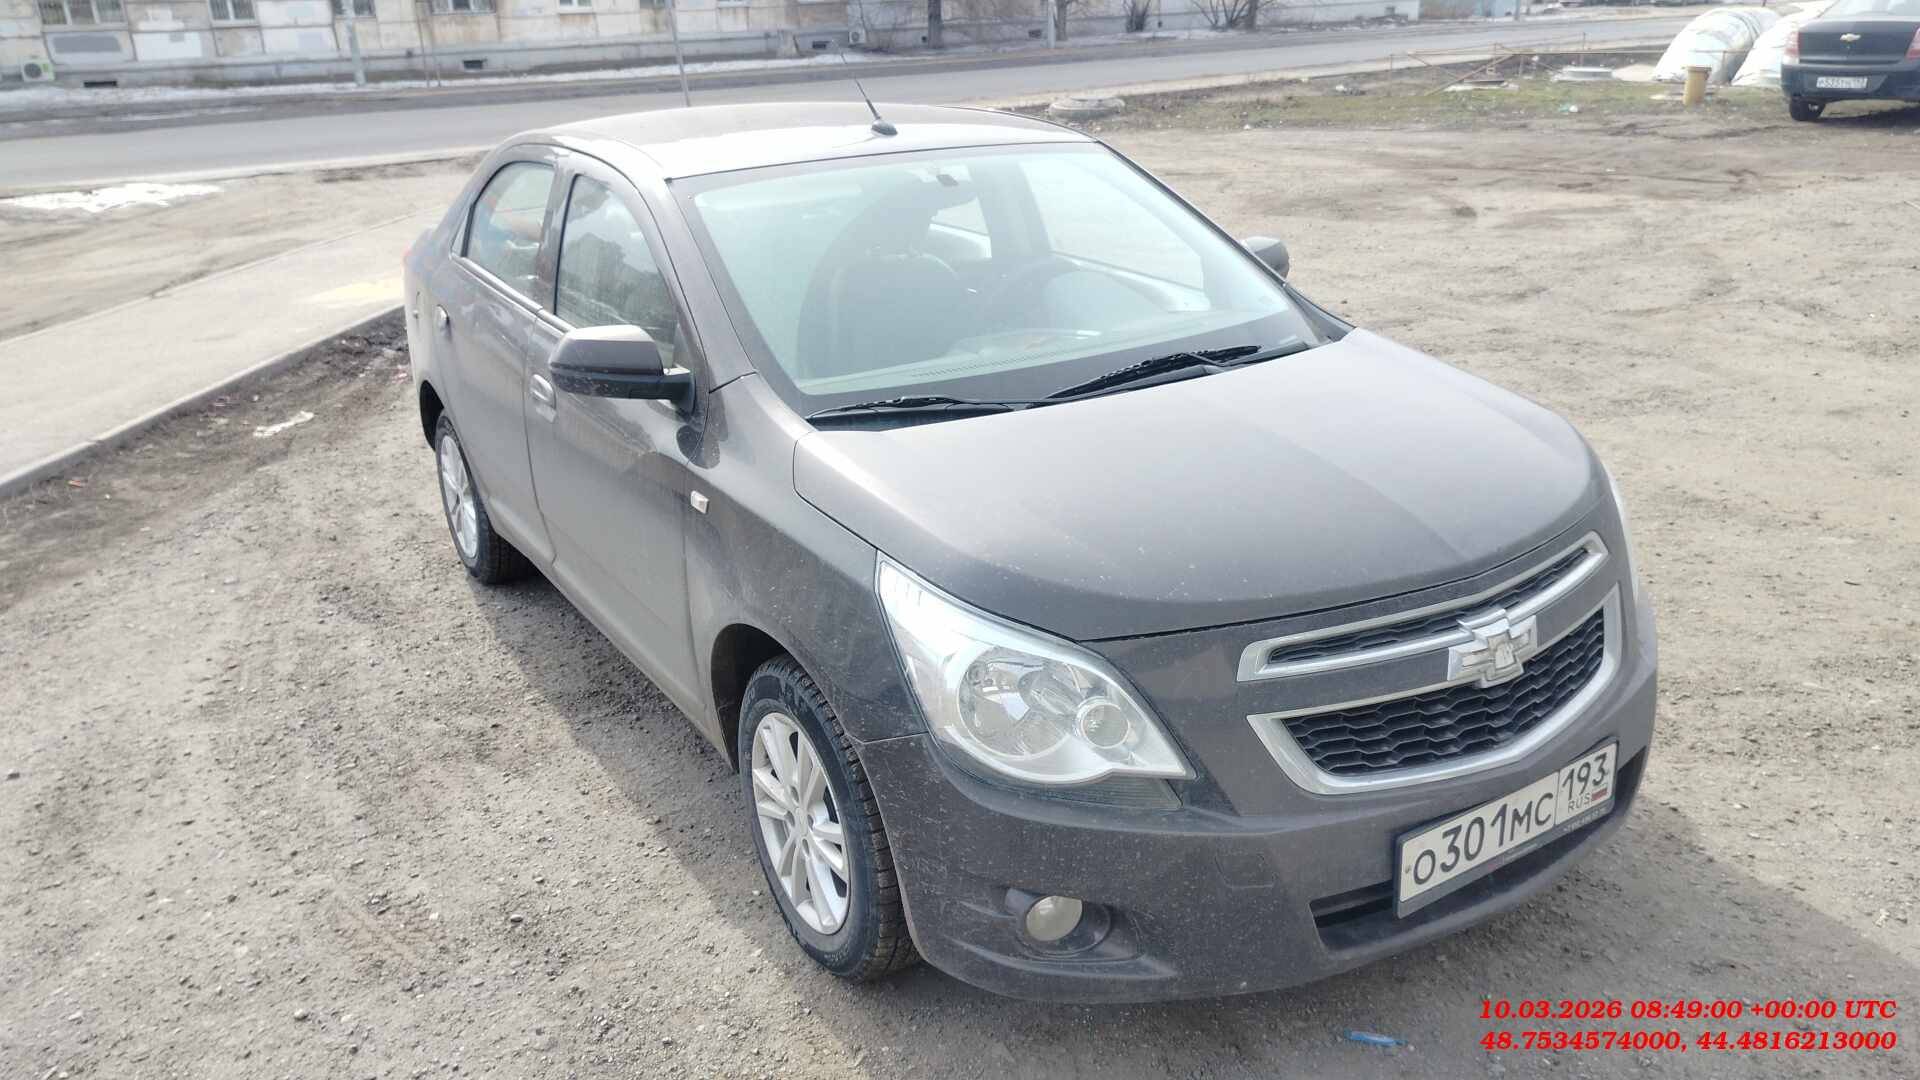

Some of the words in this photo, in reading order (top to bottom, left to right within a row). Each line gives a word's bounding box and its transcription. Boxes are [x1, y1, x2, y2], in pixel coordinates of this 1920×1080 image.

[1413, 793, 1554, 886] О301МС
[1562, 752, 1607, 801] 193
[1568, 792, 1591, 813] RUS
